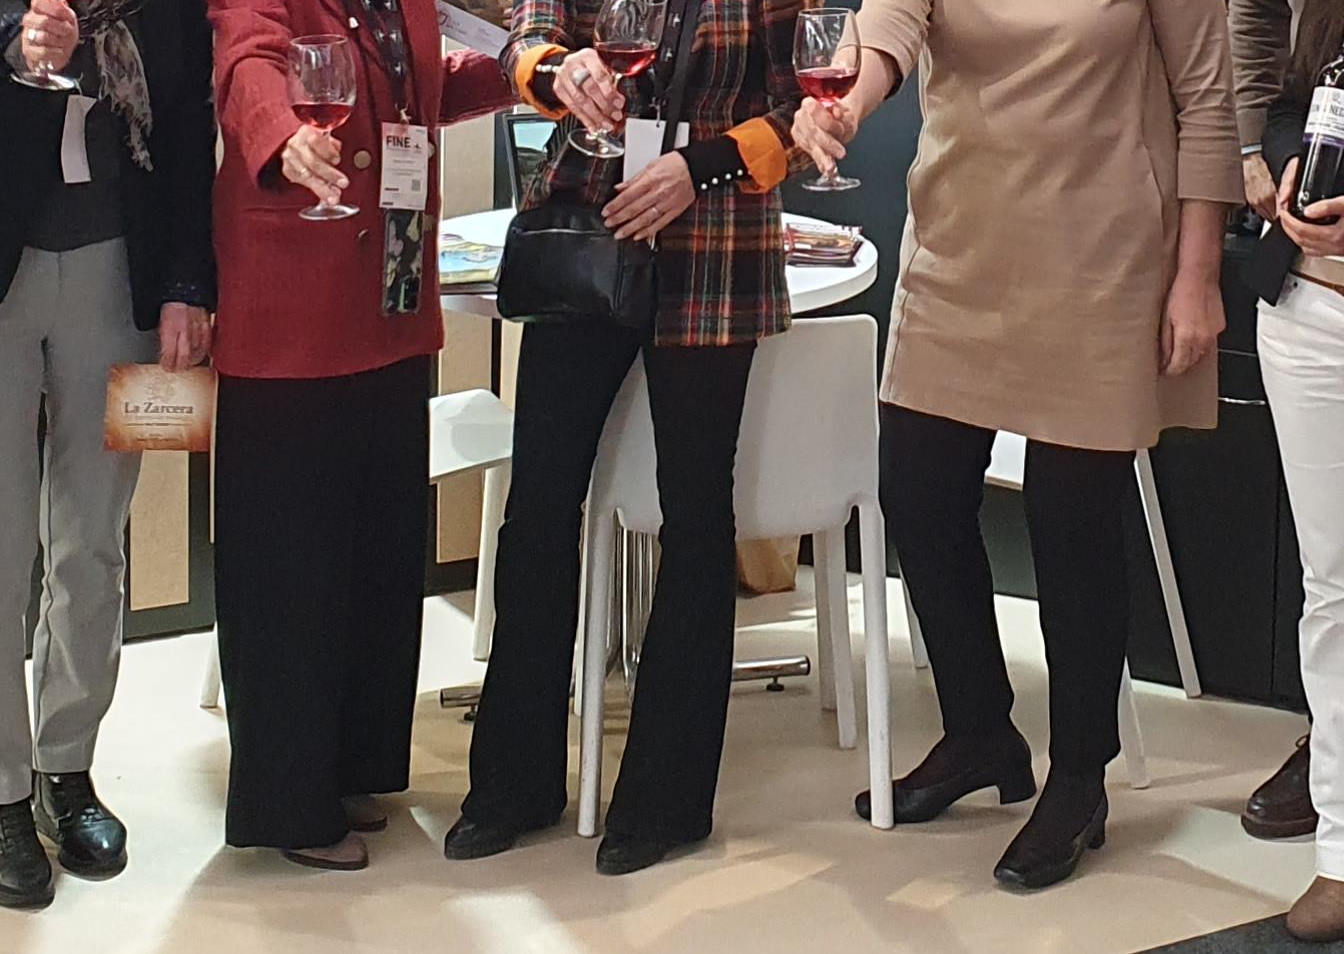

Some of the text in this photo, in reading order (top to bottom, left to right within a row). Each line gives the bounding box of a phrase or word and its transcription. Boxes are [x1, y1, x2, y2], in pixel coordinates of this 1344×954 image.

[386, 134, 411, 148] FINE
[124, 401, 194, 414] La Zarcera
